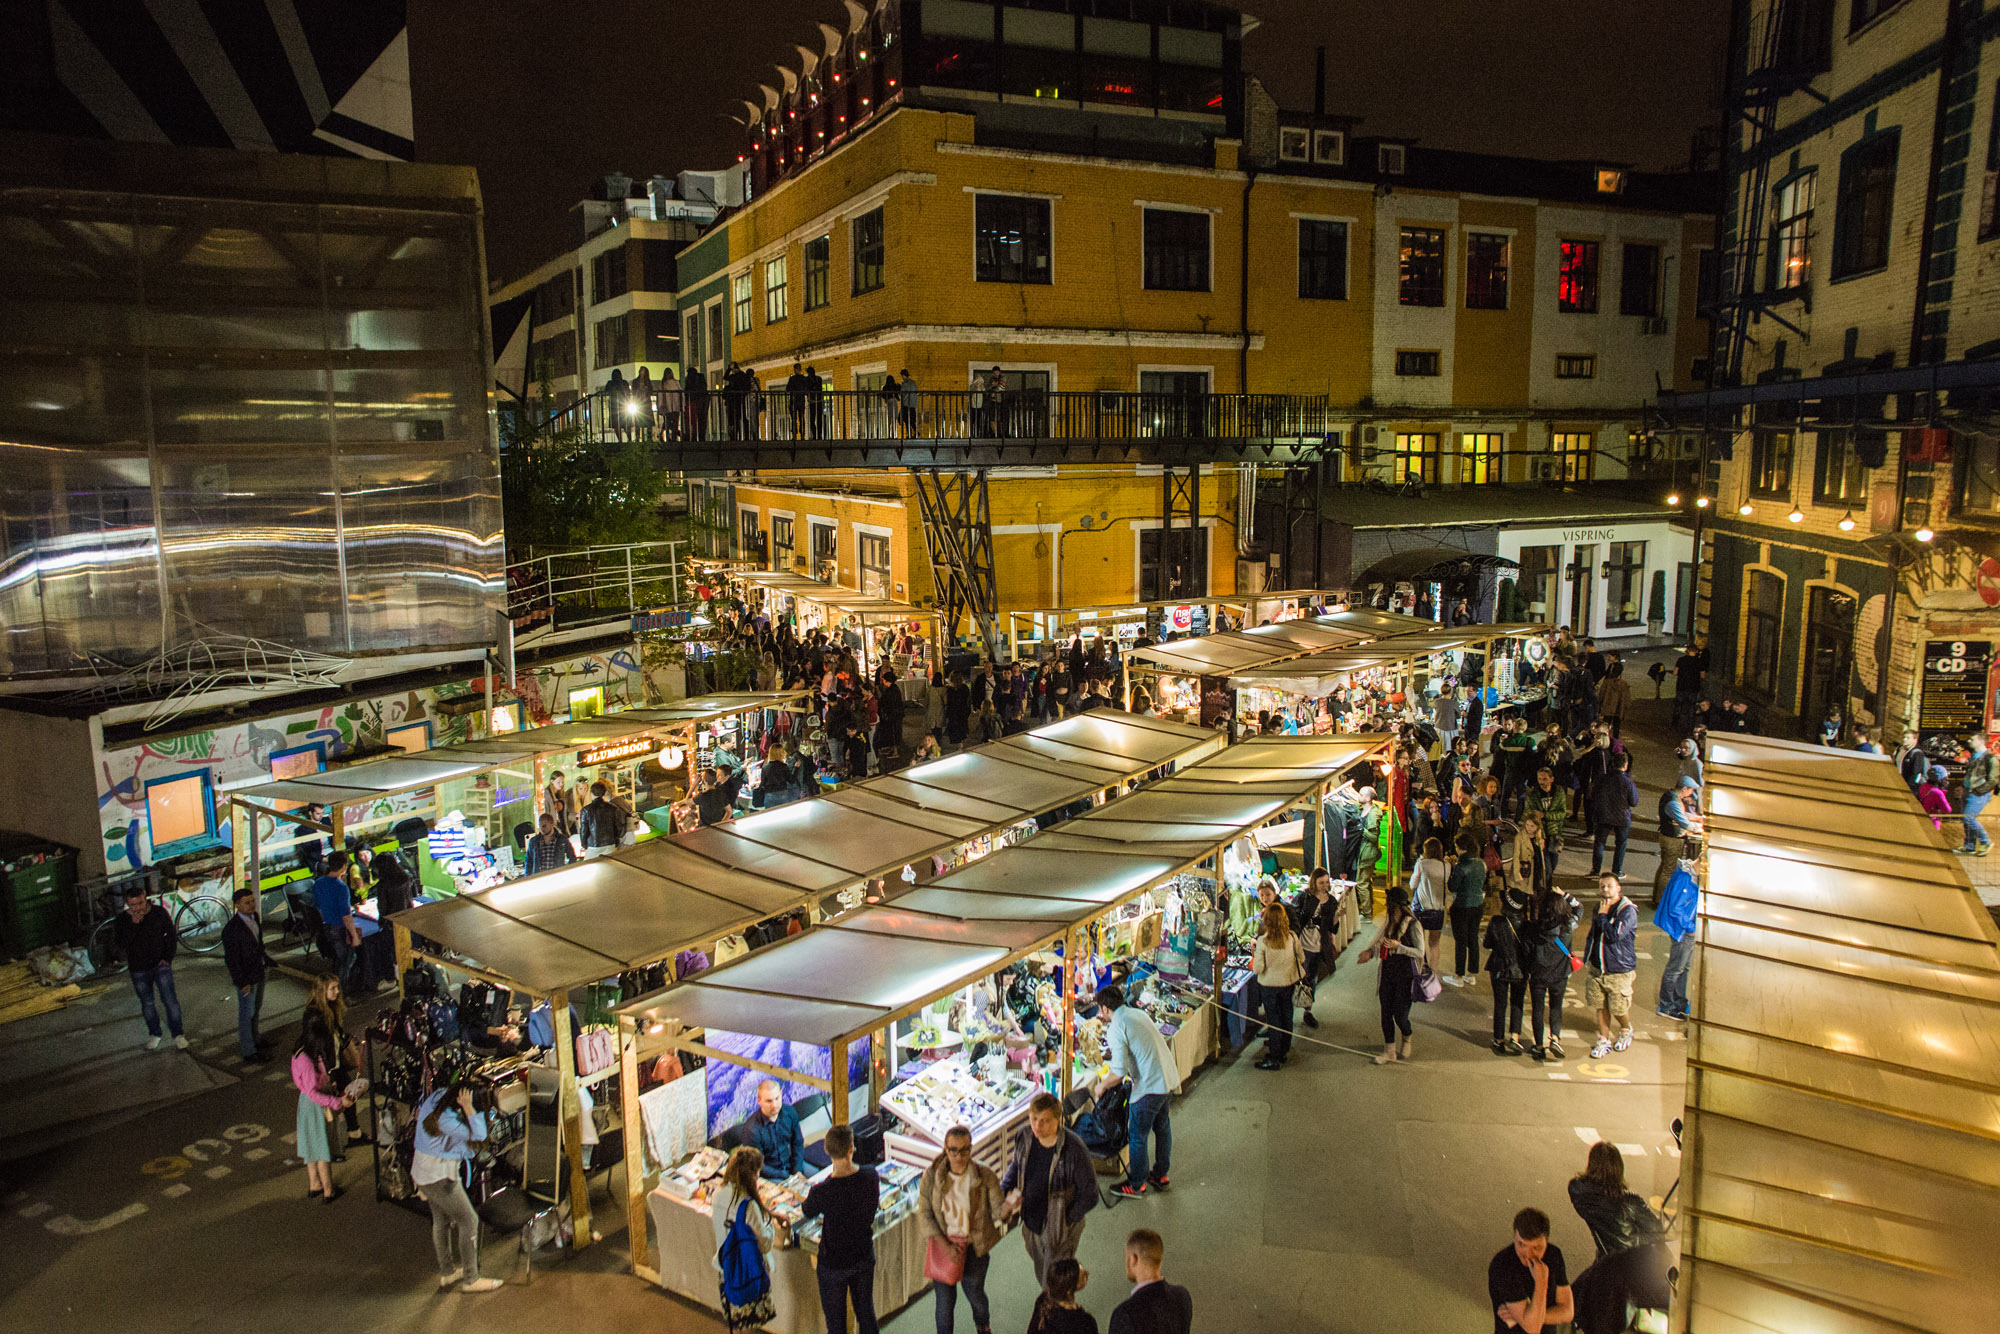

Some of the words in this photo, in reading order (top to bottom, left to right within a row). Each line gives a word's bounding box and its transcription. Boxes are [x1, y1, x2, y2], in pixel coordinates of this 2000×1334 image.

[1562, 528, 1615, 542] VISPRING
[635, 615, 663, 630] VEGAN
[664, 612, 686, 626] FOOD
[1950, 641, 1967, 657] 9
[1936, 658, 1967, 673] CD
